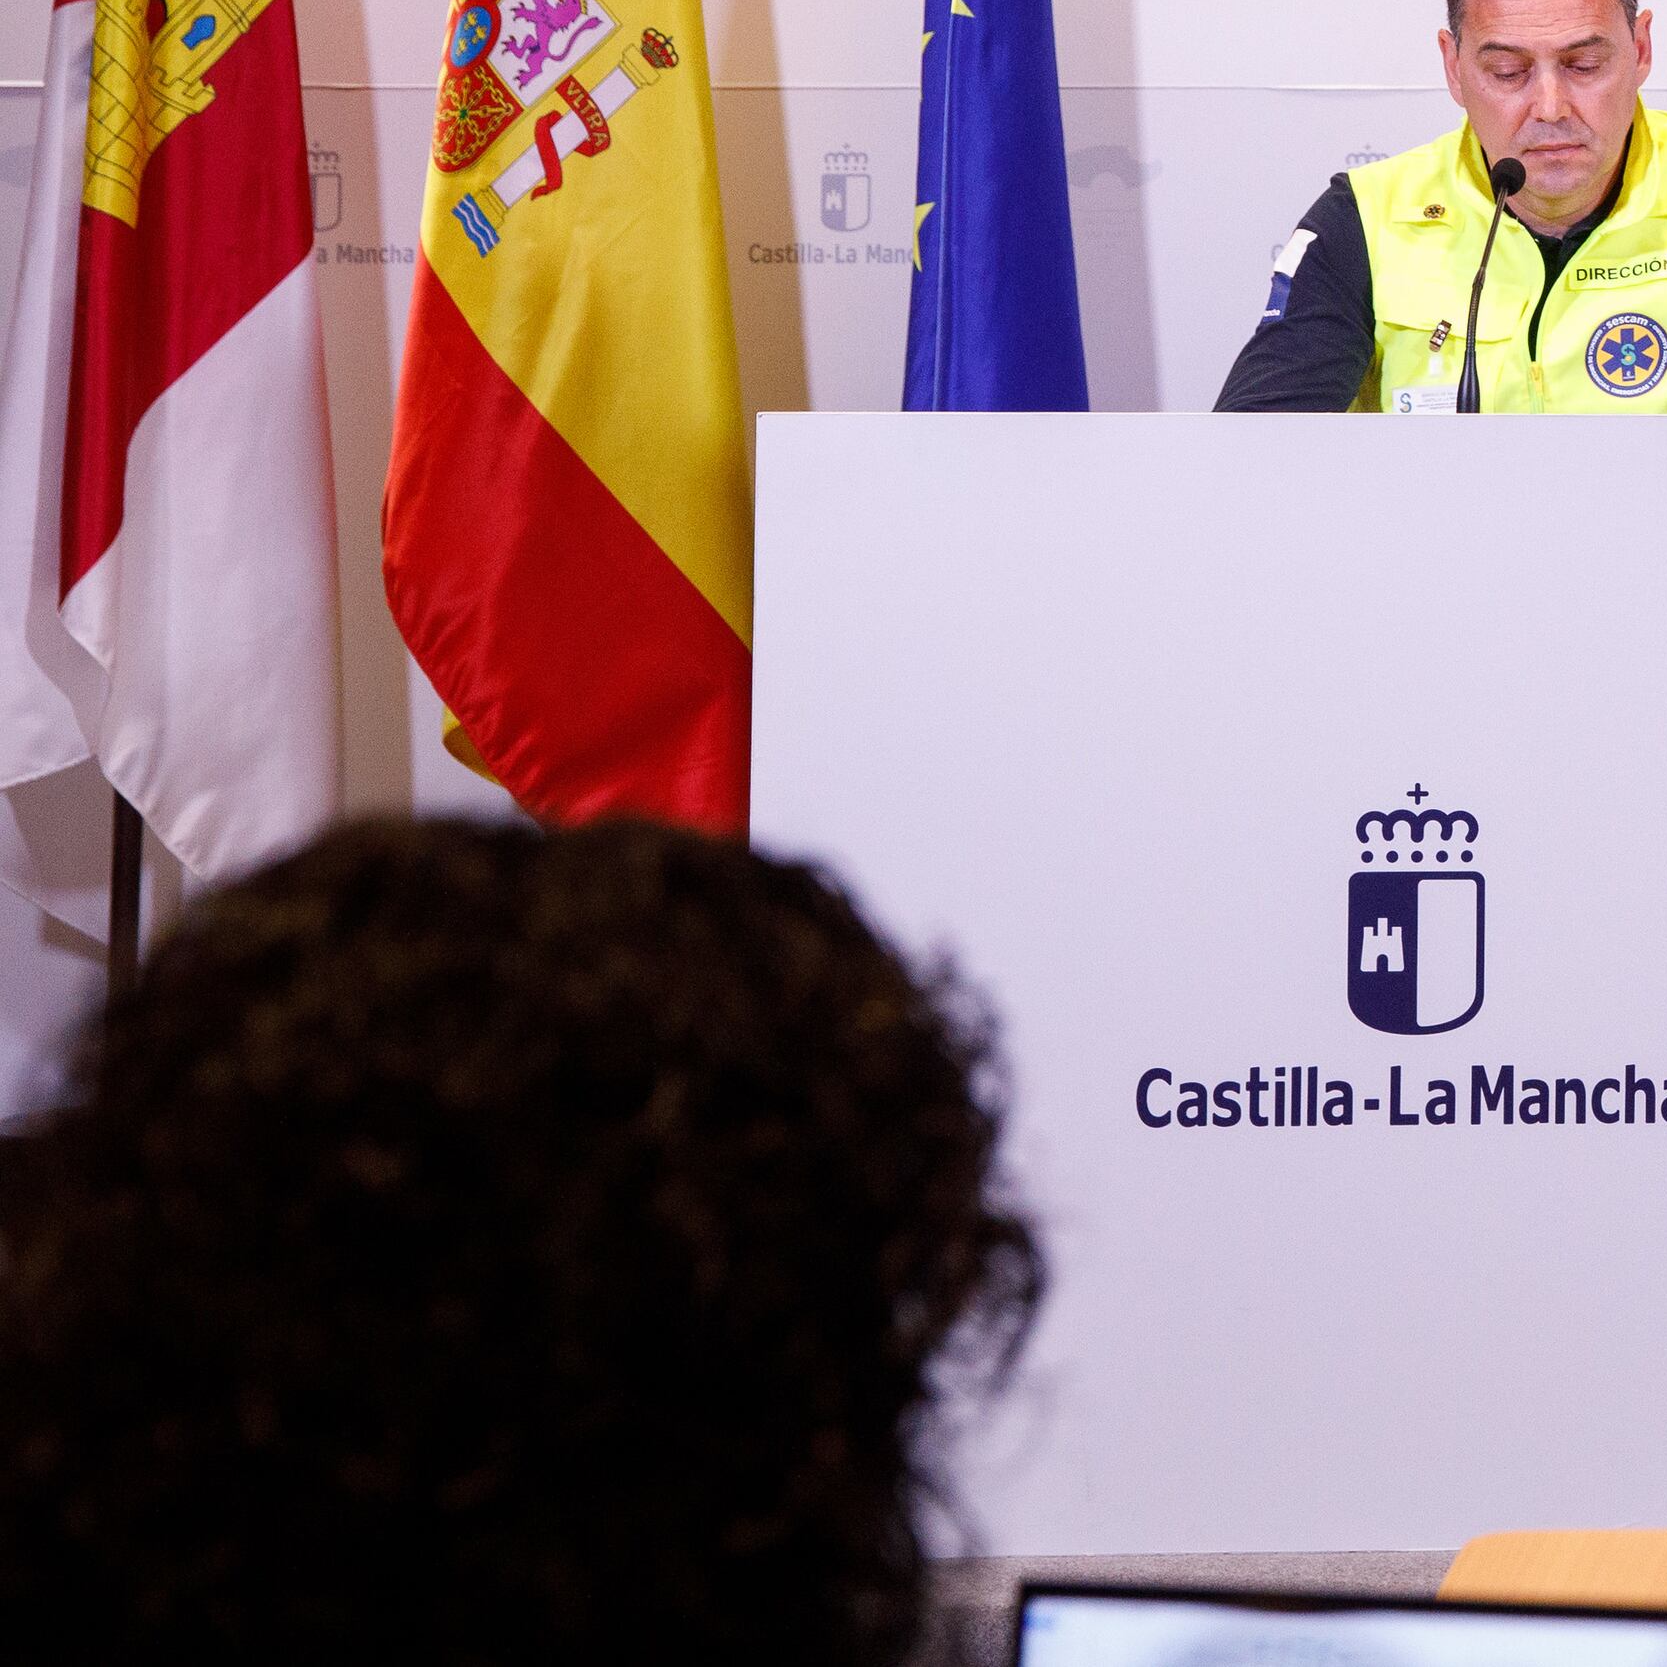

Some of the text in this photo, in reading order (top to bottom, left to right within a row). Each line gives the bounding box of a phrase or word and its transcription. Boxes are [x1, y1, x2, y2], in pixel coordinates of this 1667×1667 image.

[566, 80, 609, 147] VLTRA
[336, 244, 413, 264] Mancha
[748, 243, 914, 264] Castilla-La Manc
[1605, 315, 1649, 329] sescam
[1136, 1065, 1456, 1128] Castilla-La
